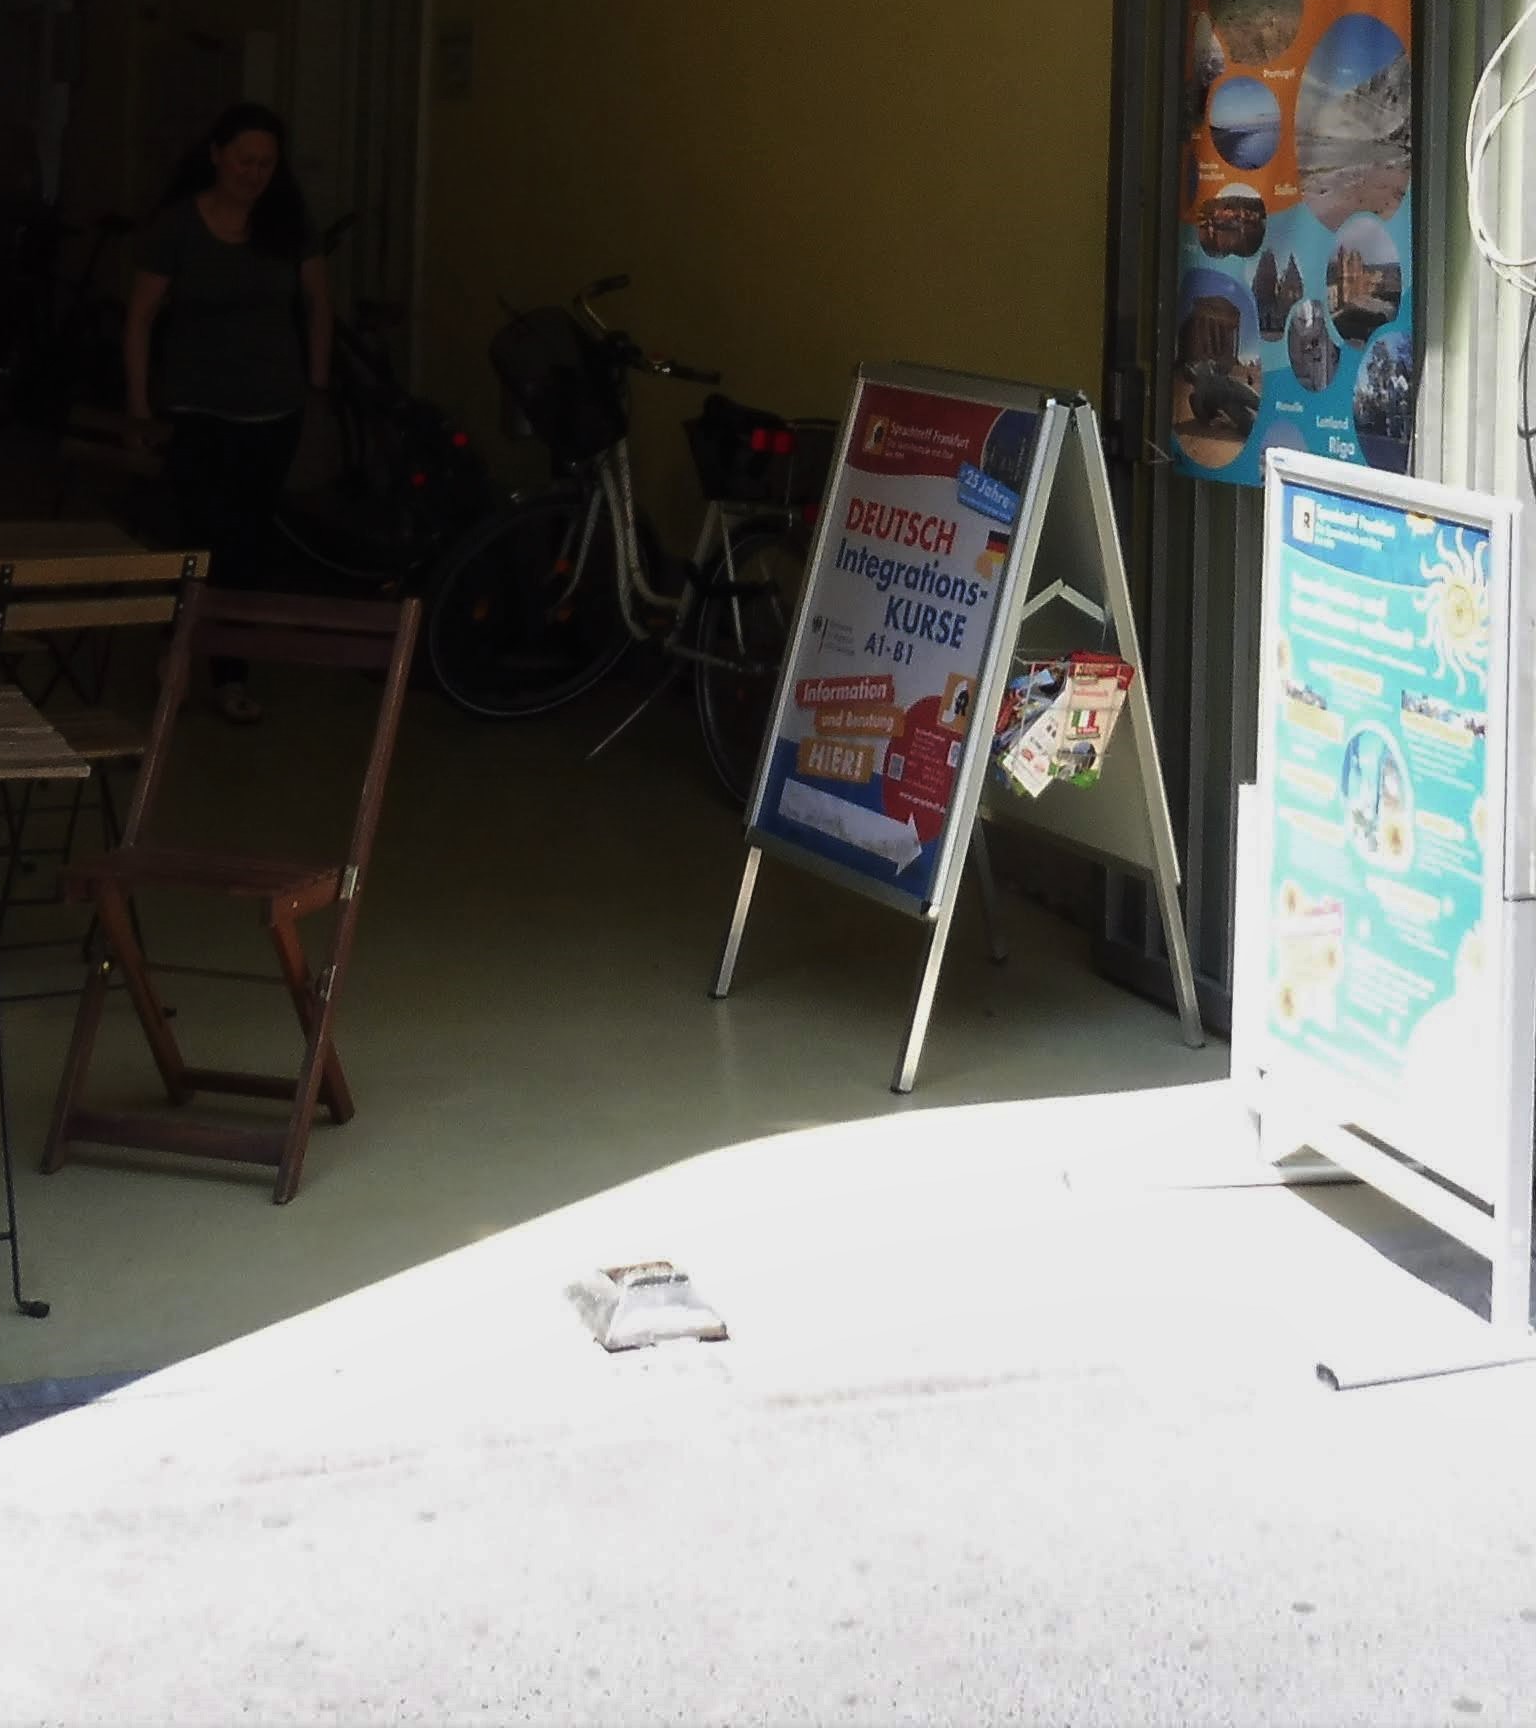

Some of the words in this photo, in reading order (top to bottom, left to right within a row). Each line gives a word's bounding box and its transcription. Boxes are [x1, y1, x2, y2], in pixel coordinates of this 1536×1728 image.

[977, 480, 1011, 509] Jahre
[845, 497, 957, 556] DEUTSCH
[835, 537, 989, 607] Integrations-
[884, 595, 967, 649] KURSE
[803, 678, 887, 702] Information
[821, 709, 844, 727] und
[808, 744, 864, 778] HIER!
